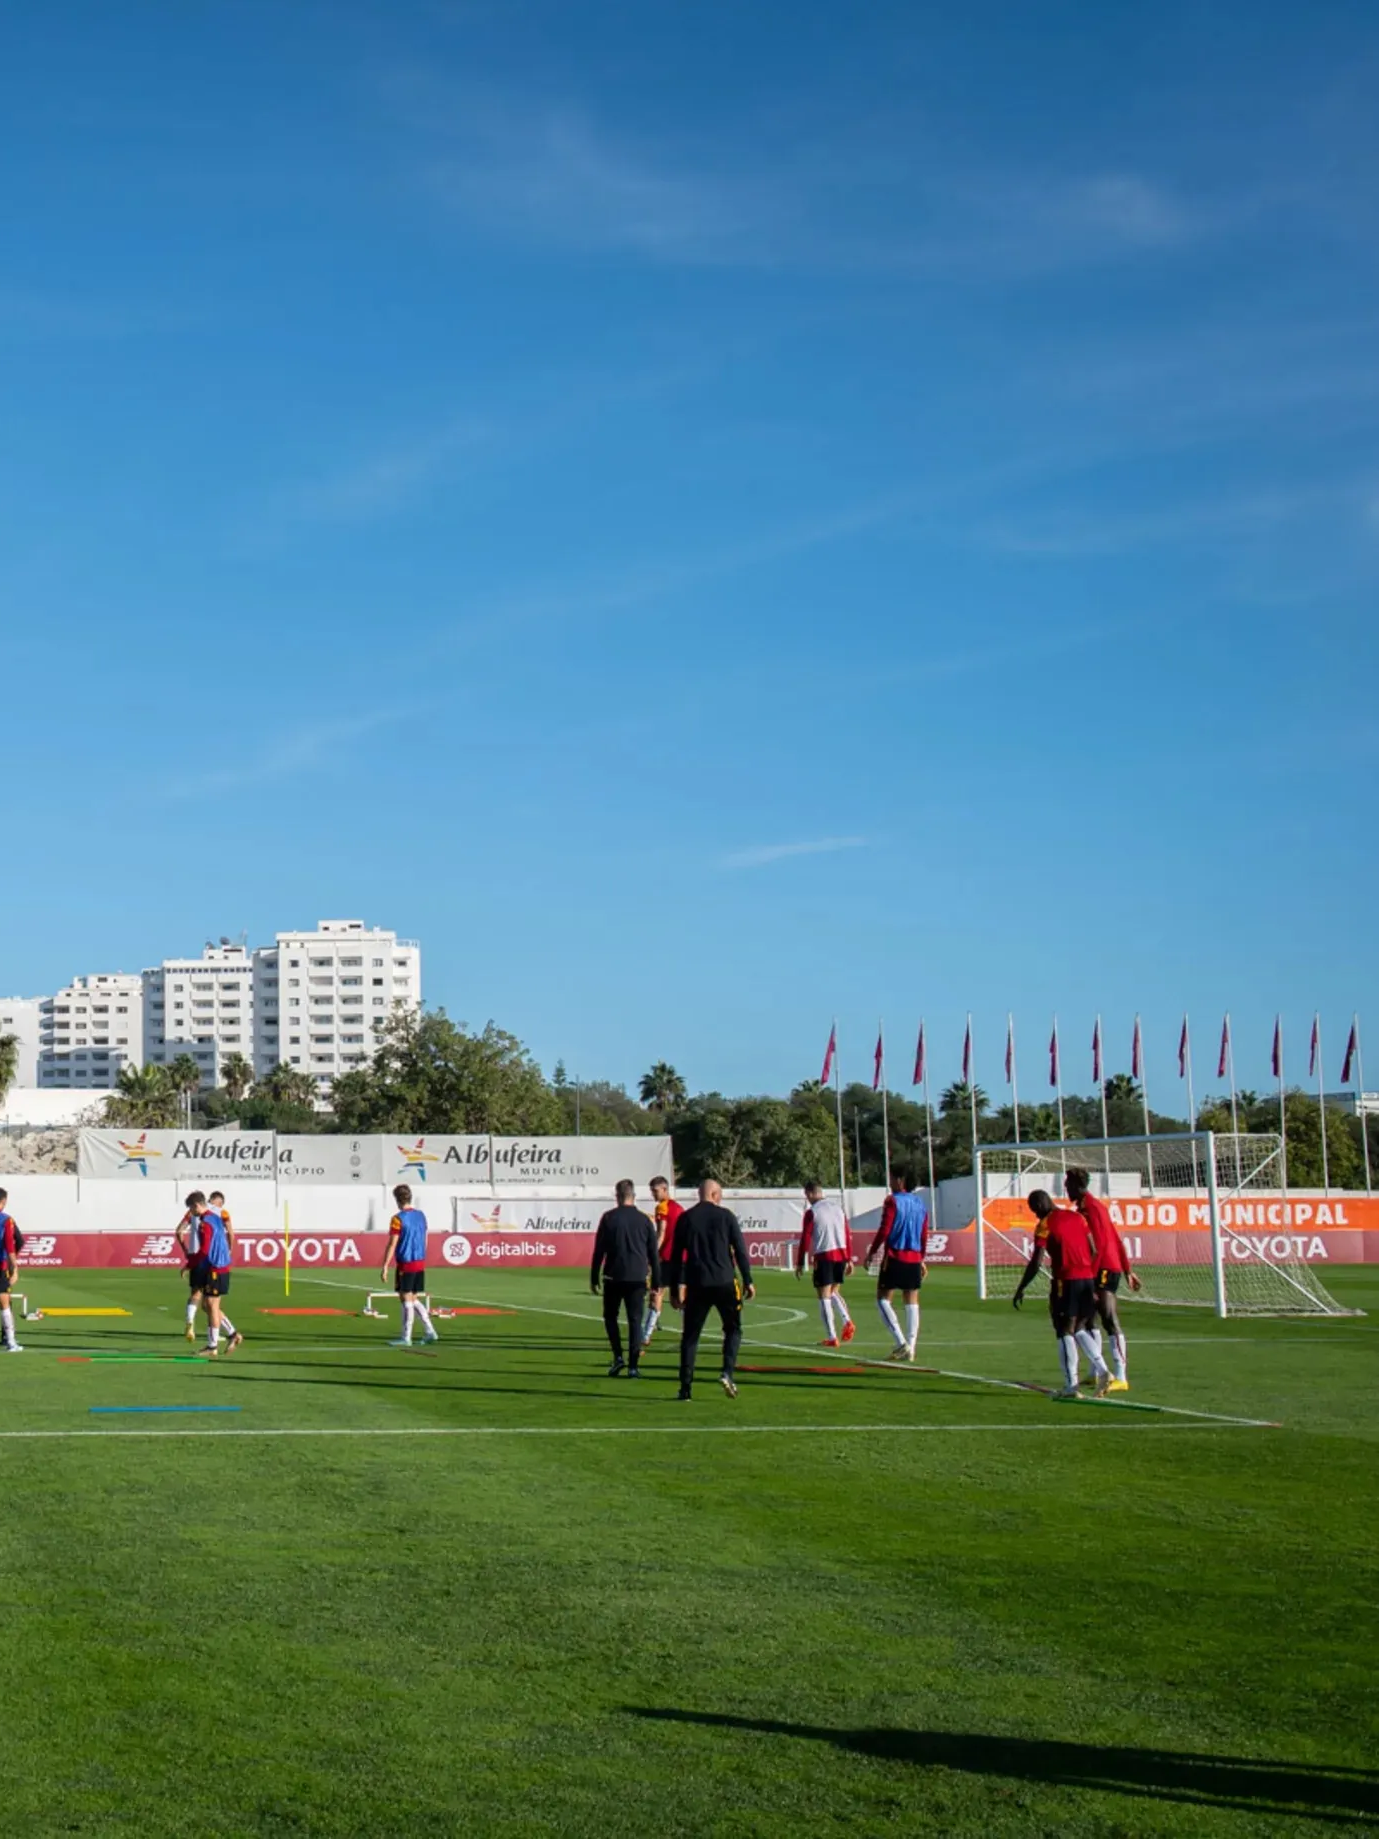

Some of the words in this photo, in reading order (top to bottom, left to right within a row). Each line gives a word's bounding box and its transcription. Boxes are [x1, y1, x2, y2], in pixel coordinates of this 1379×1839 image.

[173, 1138, 293, 1163] Albufeira
[443, 1142, 561, 1168] Albufeira
[525, 1216, 591, 1231] Albufeira
[1188, 1203, 1349, 1226] MUNICIPAL
[238, 1238, 362, 1262] TOYOTA
[476, 1242, 556, 1259] digitalbits
[1219, 1236, 1329, 1259] TOYOTA
[149, 1257, 181, 1265] balance
